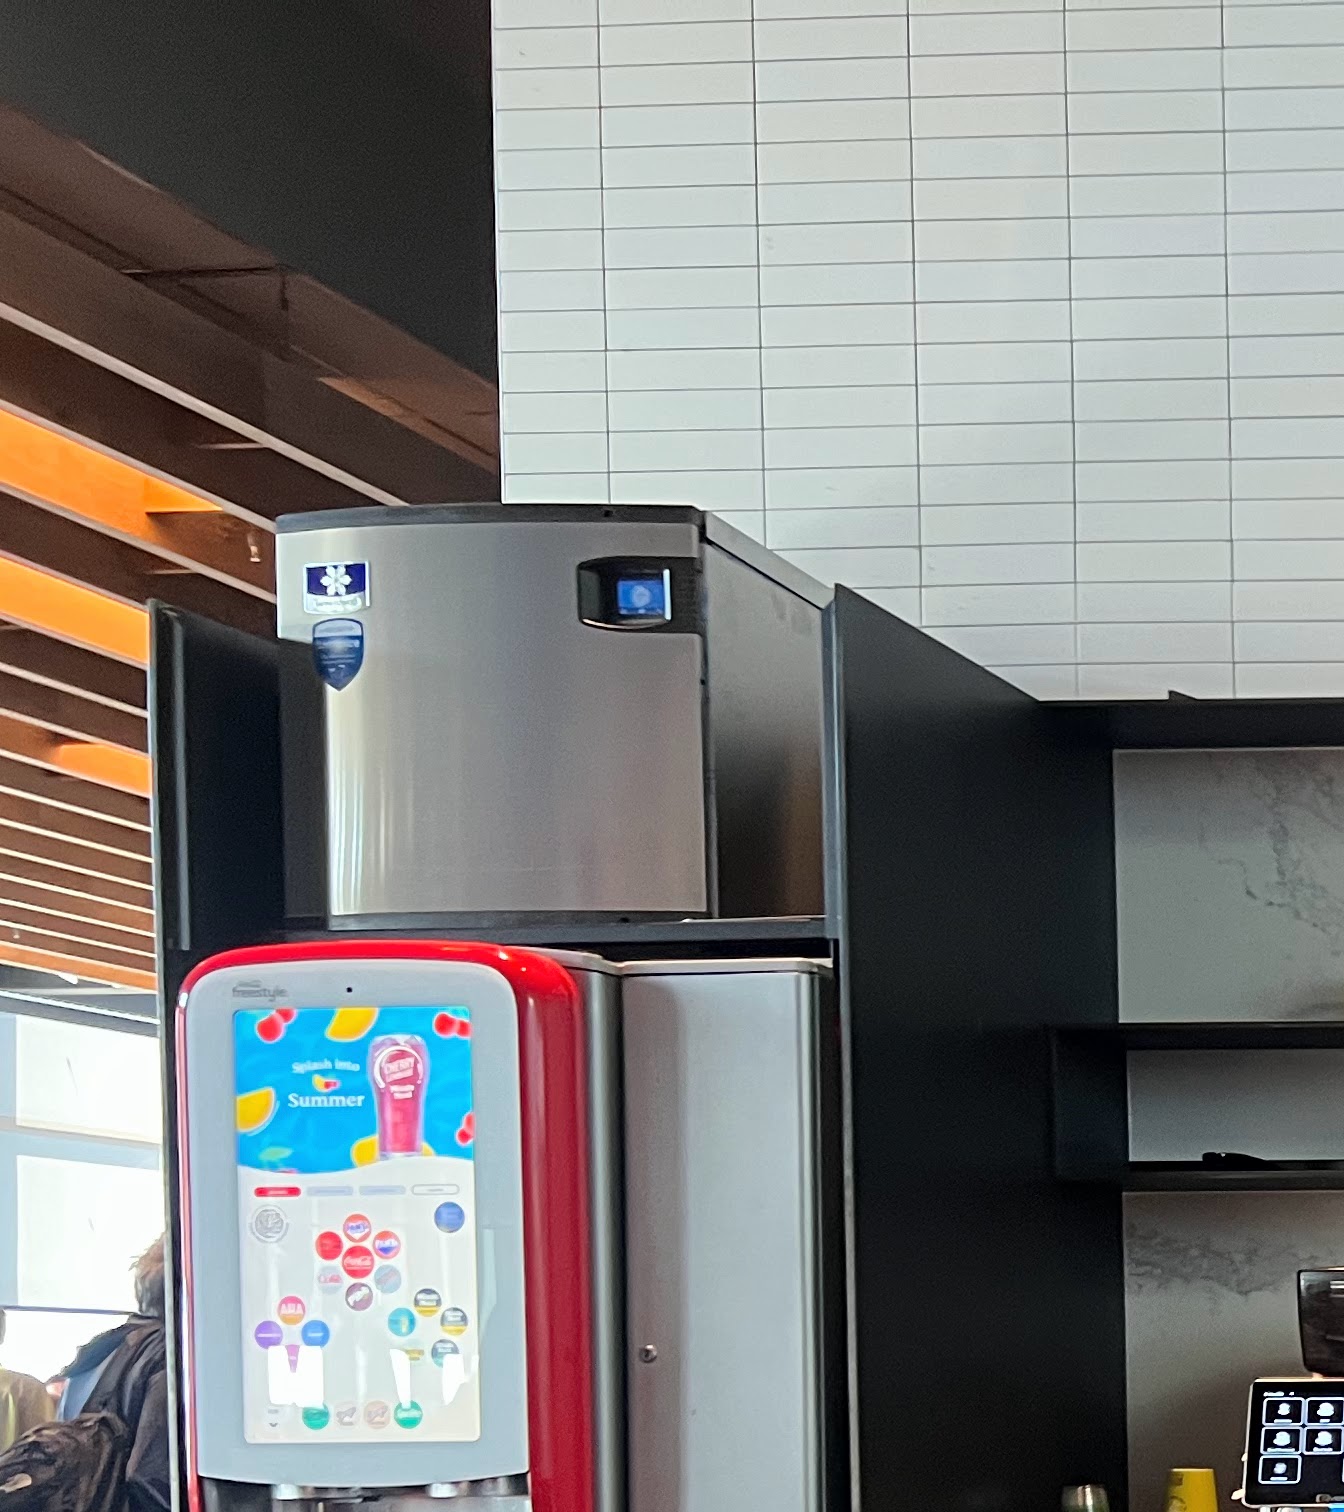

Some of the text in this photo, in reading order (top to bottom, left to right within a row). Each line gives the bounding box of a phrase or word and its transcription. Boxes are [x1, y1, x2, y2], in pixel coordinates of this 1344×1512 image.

[231, 985, 289, 1002] freestyle
[291, 1058, 361, 1075] Splash into
[287, 1092, 366, 1109] Summer
